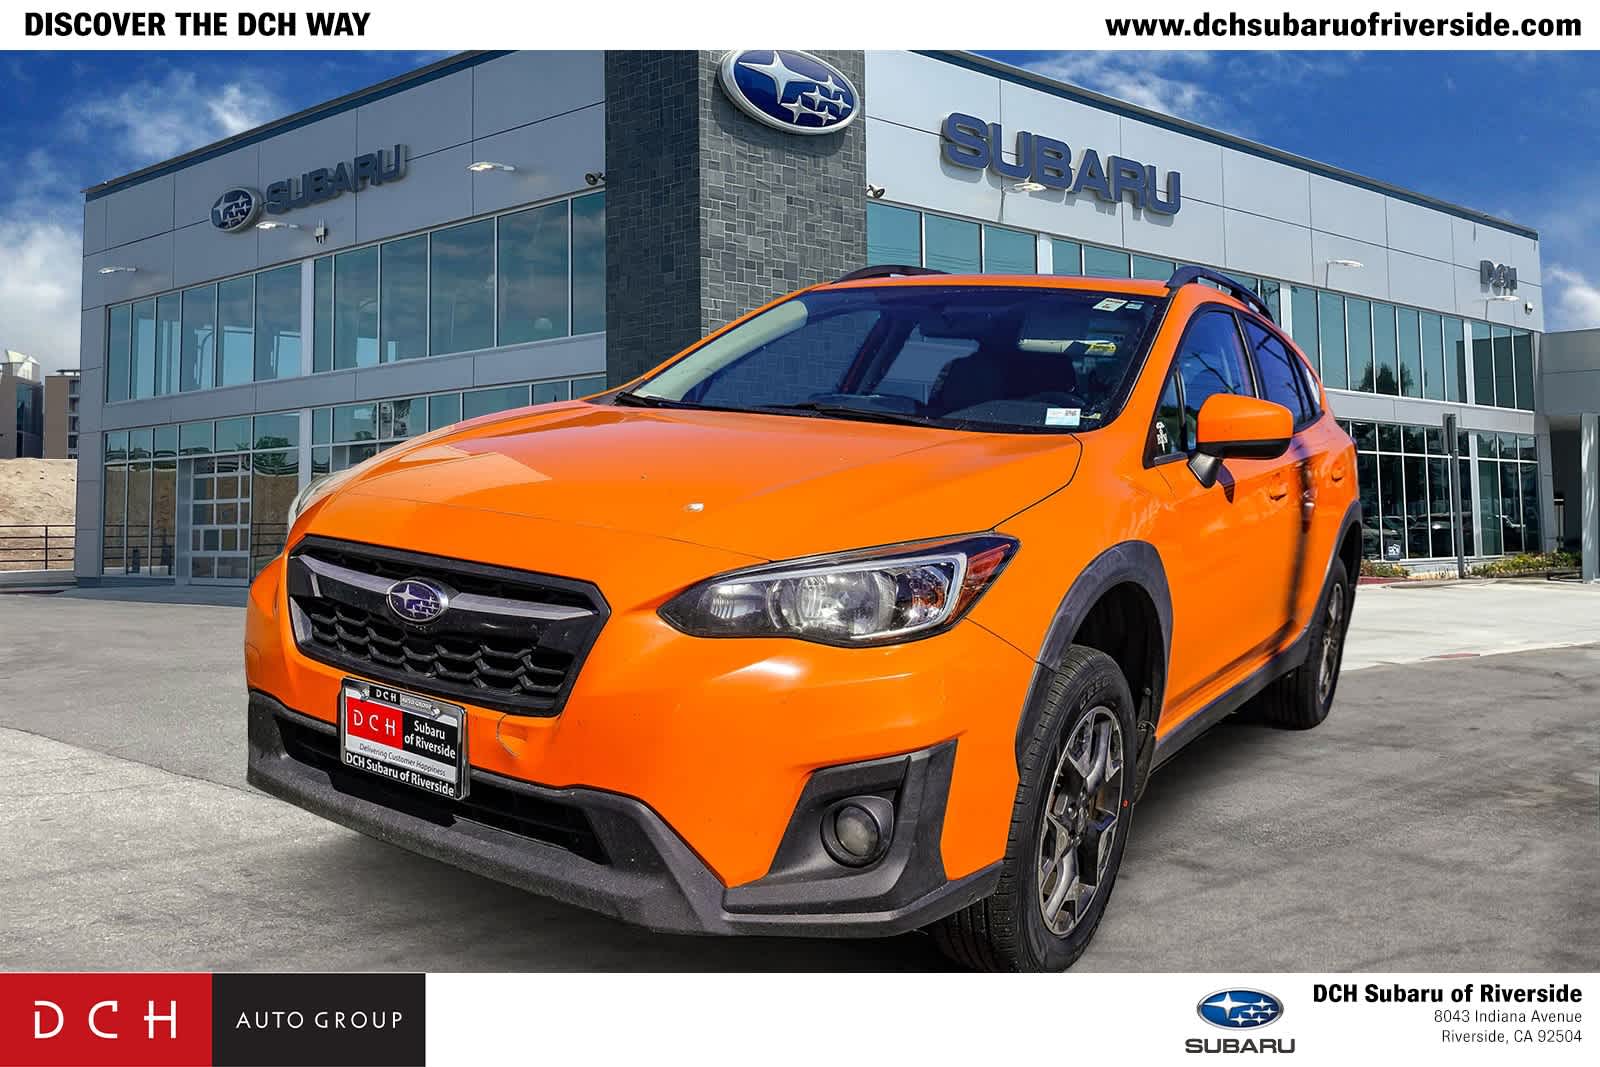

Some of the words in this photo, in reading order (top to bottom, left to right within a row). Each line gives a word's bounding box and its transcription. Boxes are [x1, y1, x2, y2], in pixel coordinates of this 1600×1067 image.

[266, 144, 407, 214] SUBARU
[941, 112, 1181, 215] SUBARU
[375, 689, 397, 702] DCH
[353, 709, 396, 737] DCH
[414, 720, 446, 740] Subaru
[359, 743, 388, 759] Delivering
[388, 751, 416, 766] Customer
[416, 761, 446, 777] Happiness
[404, 734, 414, 746] of
[415, 735, 456, 760] Riverside
[346, 752, 365, 769] DCH
[366, 759, 399, 779] Subaru
[399, 770, 410, 782] of
[411, 774, 455, 798] Riverside
